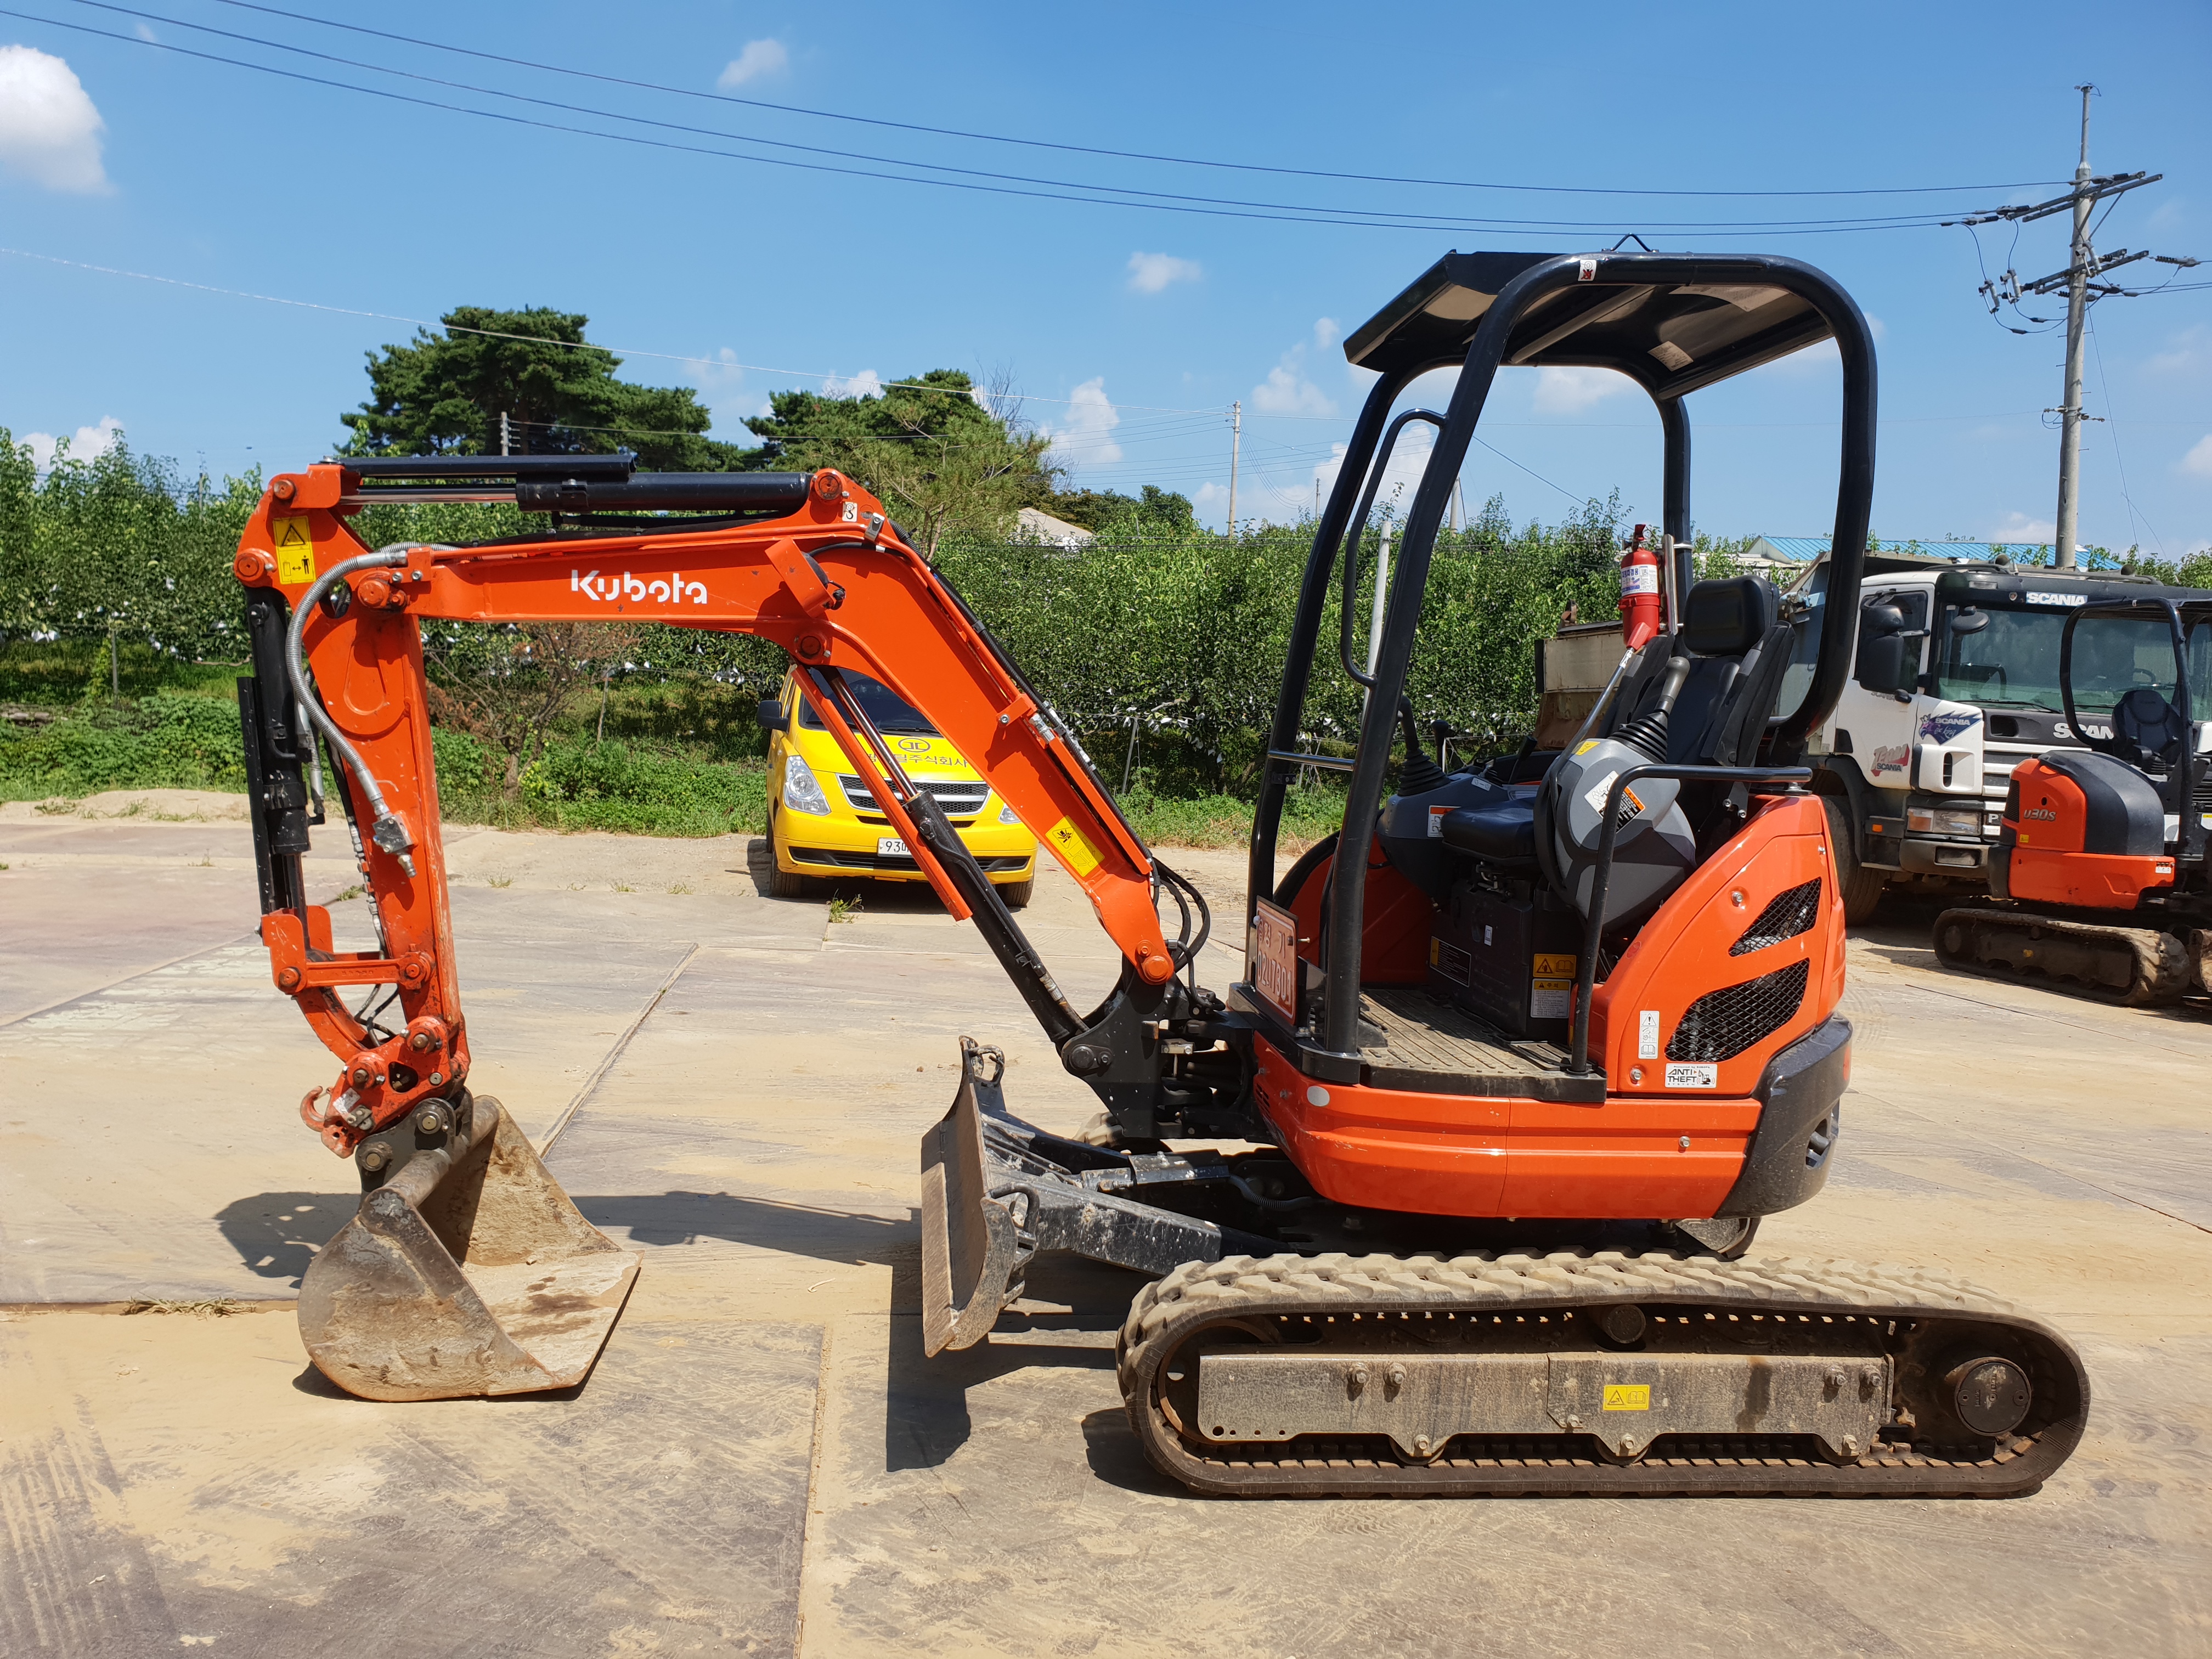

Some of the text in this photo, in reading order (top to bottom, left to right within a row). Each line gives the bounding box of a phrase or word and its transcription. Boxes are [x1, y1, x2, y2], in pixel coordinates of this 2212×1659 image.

[571, 569, 707, 604] Kubota
[2028, 593, 2086, 606] SCANIA
[1877, 763, 1902, 771] SCANIA
